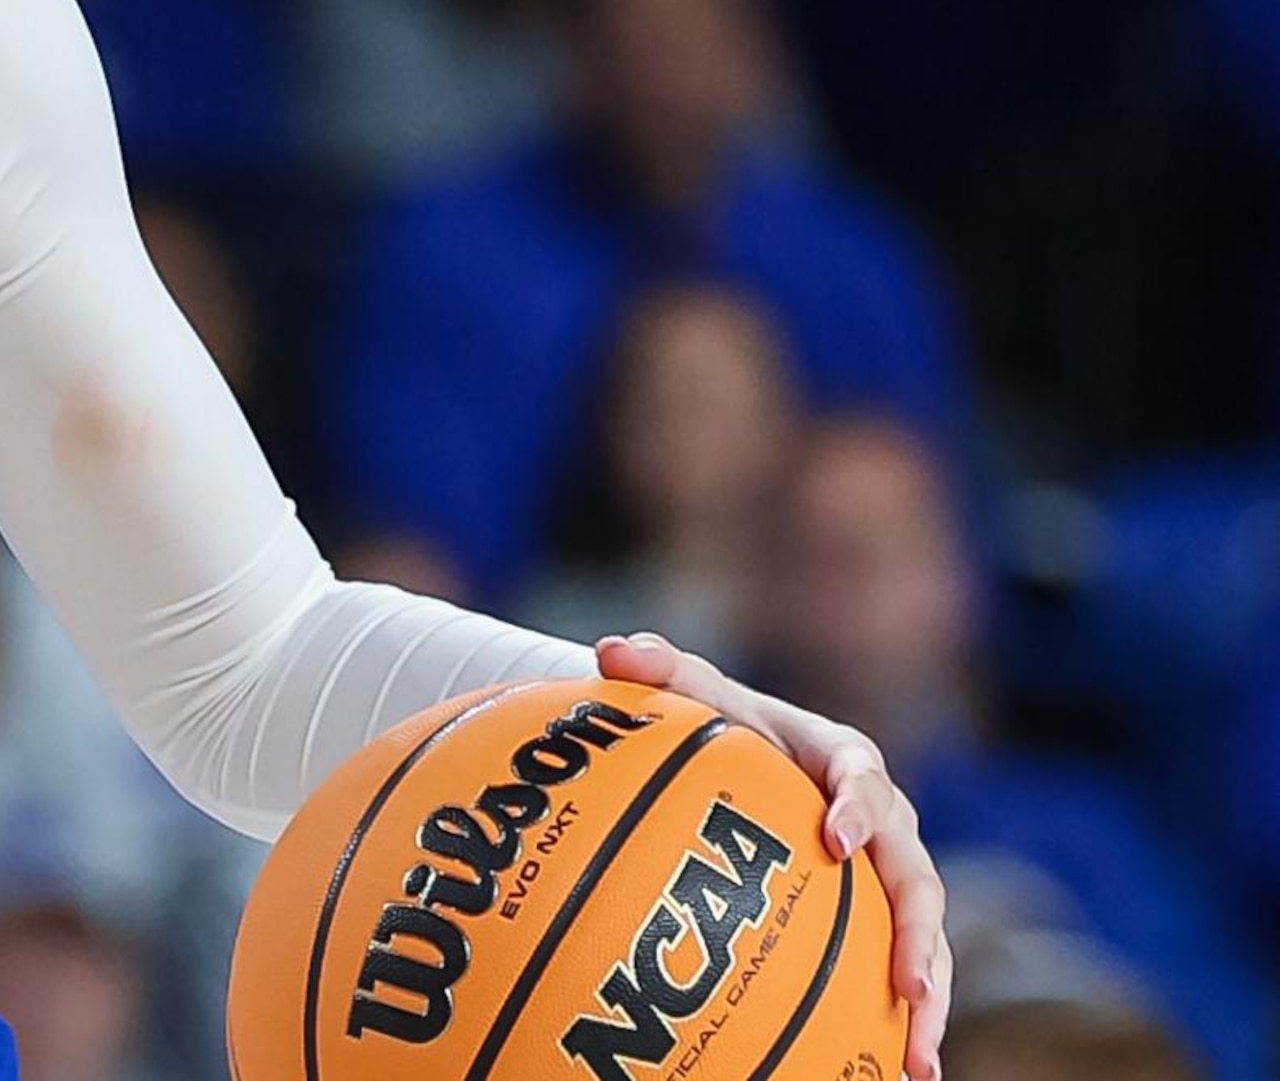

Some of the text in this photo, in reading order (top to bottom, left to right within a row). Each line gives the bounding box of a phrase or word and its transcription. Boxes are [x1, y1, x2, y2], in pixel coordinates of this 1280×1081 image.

[345, 700, 653, 1045] Wilson
[498, 800, 580, 921] EVO NXT
[557, 798, 794, 1081] NCAA
[726, 927, 780, 1007] GAME
[775, 869, 812, 929] BALL
